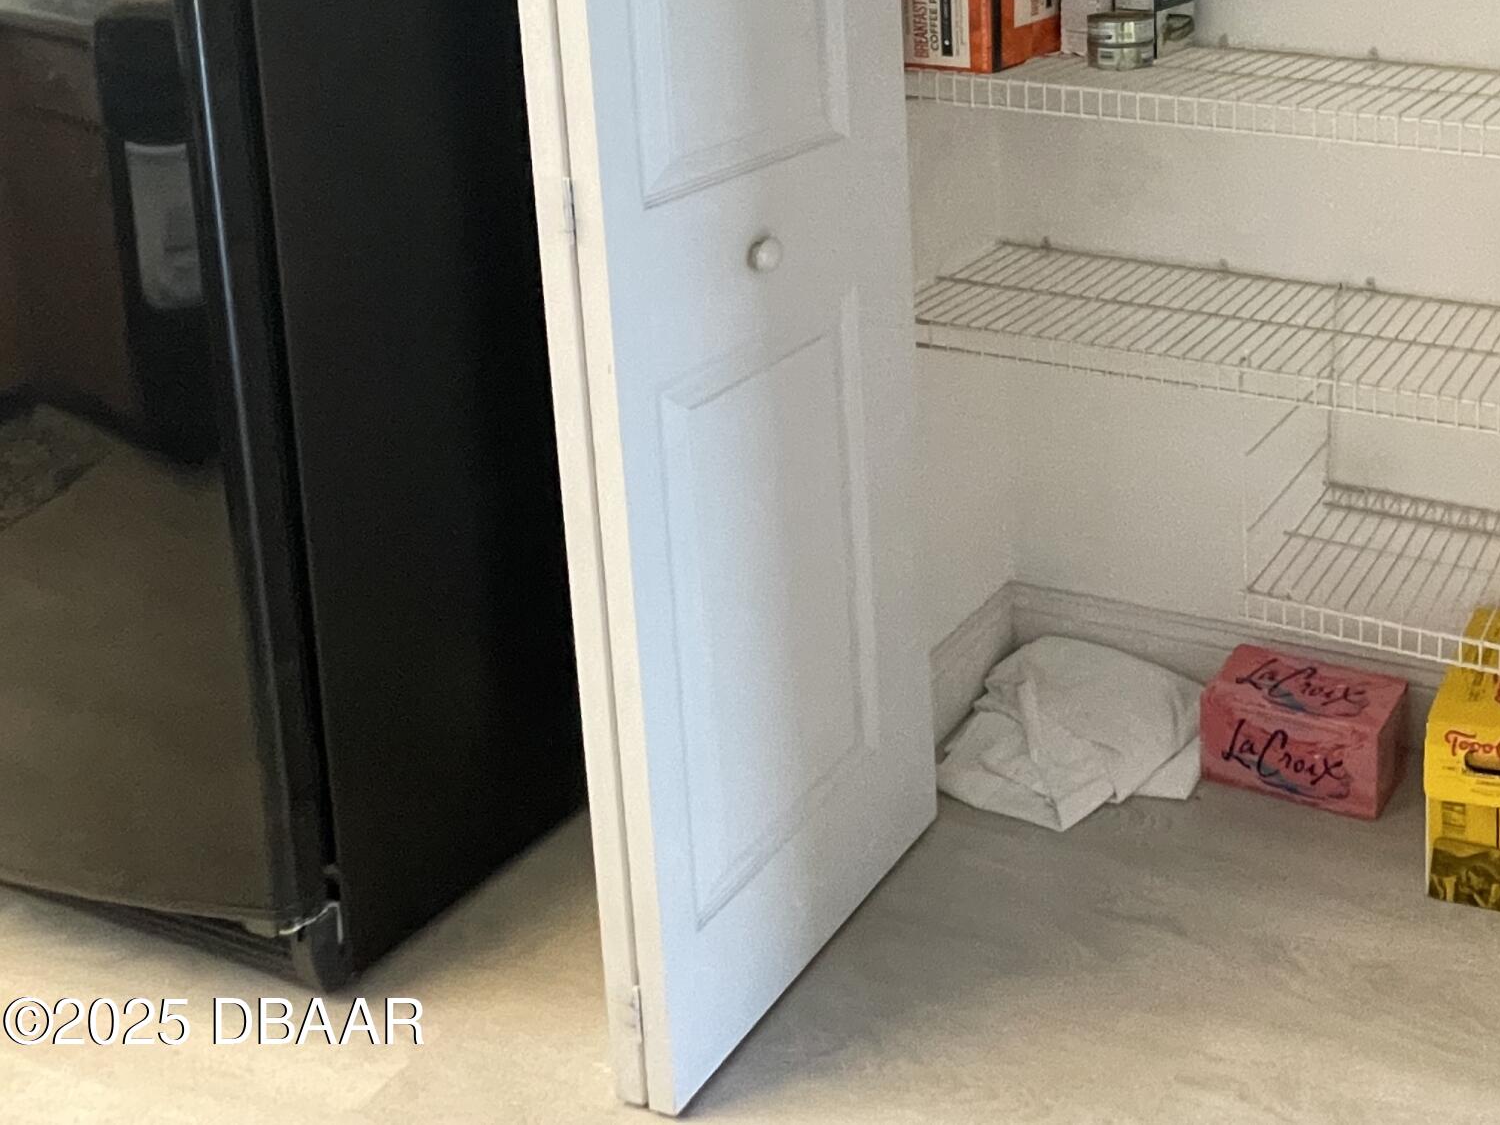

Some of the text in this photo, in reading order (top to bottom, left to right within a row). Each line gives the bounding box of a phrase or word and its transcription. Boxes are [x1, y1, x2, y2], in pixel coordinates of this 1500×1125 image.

[912, 1, 929, 58] BREAKFAST
[929, 7, 939, 51] COFFEE
[1444, 730, 1495, 757] Topo
